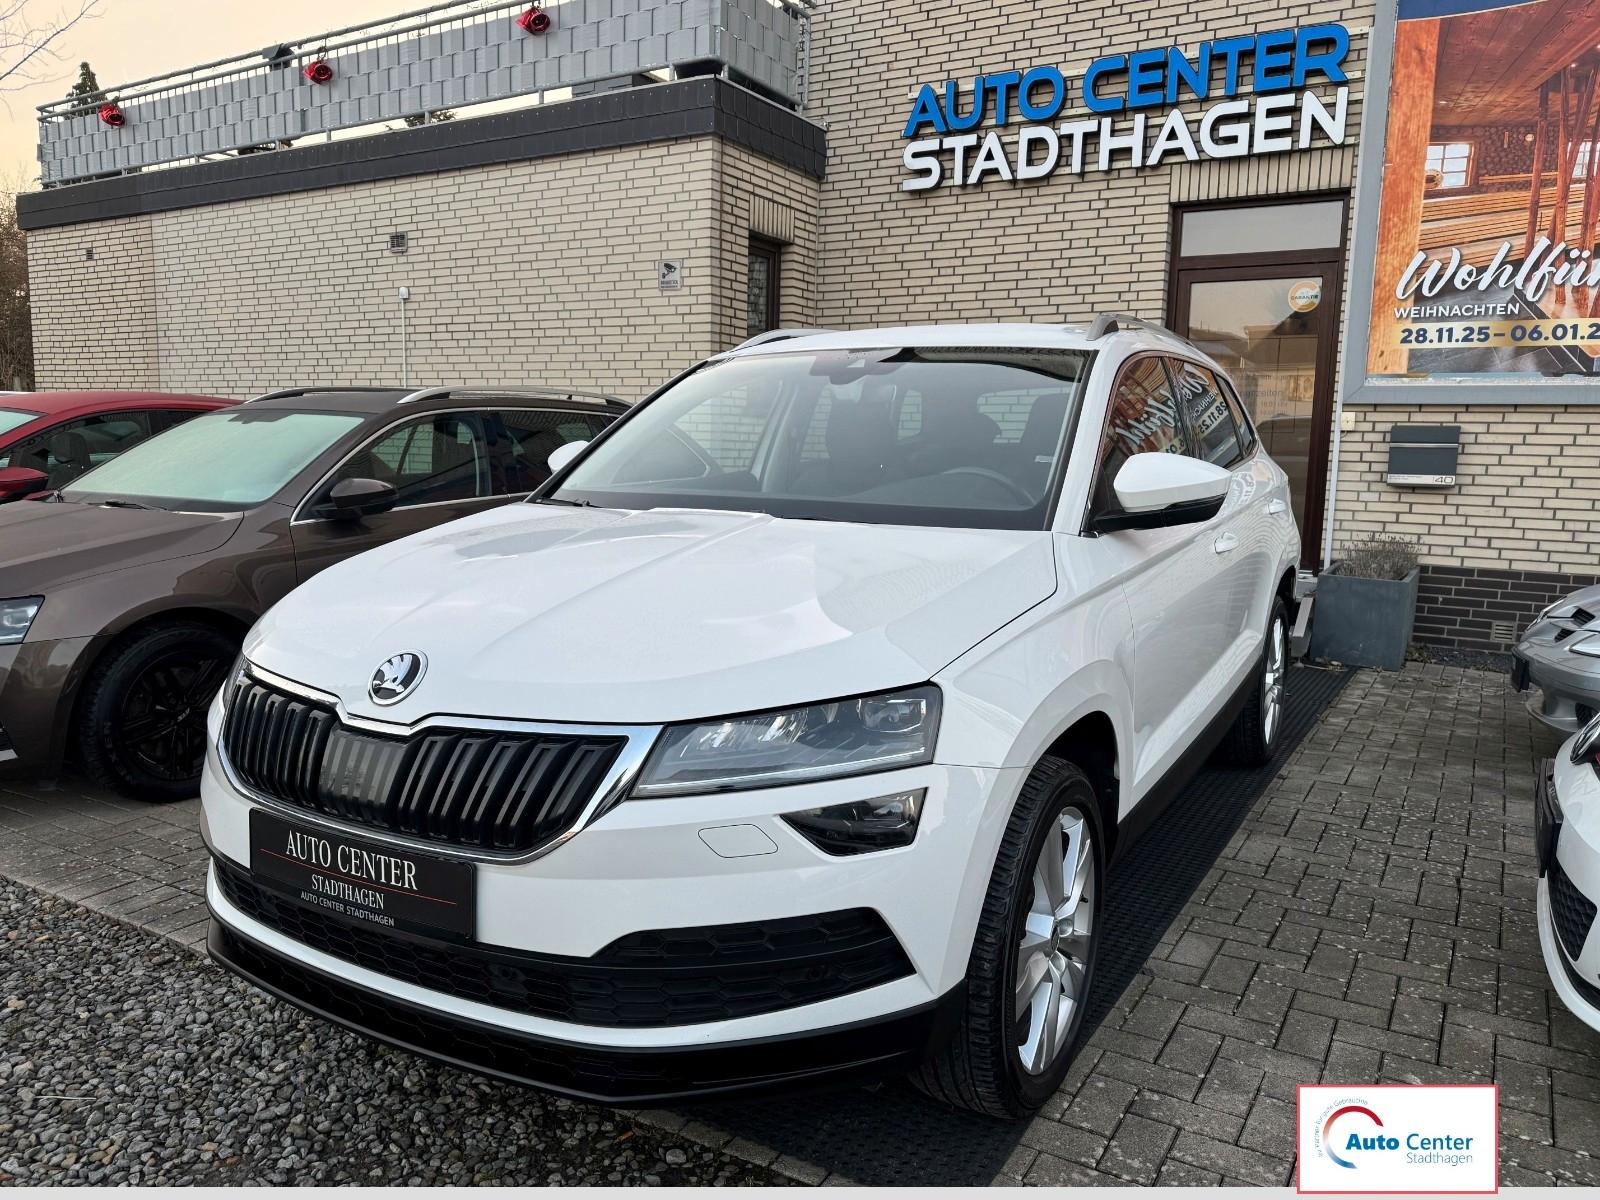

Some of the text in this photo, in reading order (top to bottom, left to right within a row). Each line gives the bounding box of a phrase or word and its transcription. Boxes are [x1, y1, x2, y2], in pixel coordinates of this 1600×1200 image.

[903, 23, 1350, 138] AUTO CENTER
[902, 87, 1350, 192] STADTHAGEN
[1394, 303, 1520, 319] WEIHNACHTEN
[1434, 476, 1454, 484] 40
[286, 829, 418, 891] AUTO CENTER
[300, 891, 395, 927] AUTO CENTER STADTHAGEN
[311, 874, 385, 910] STADTHAGEN
